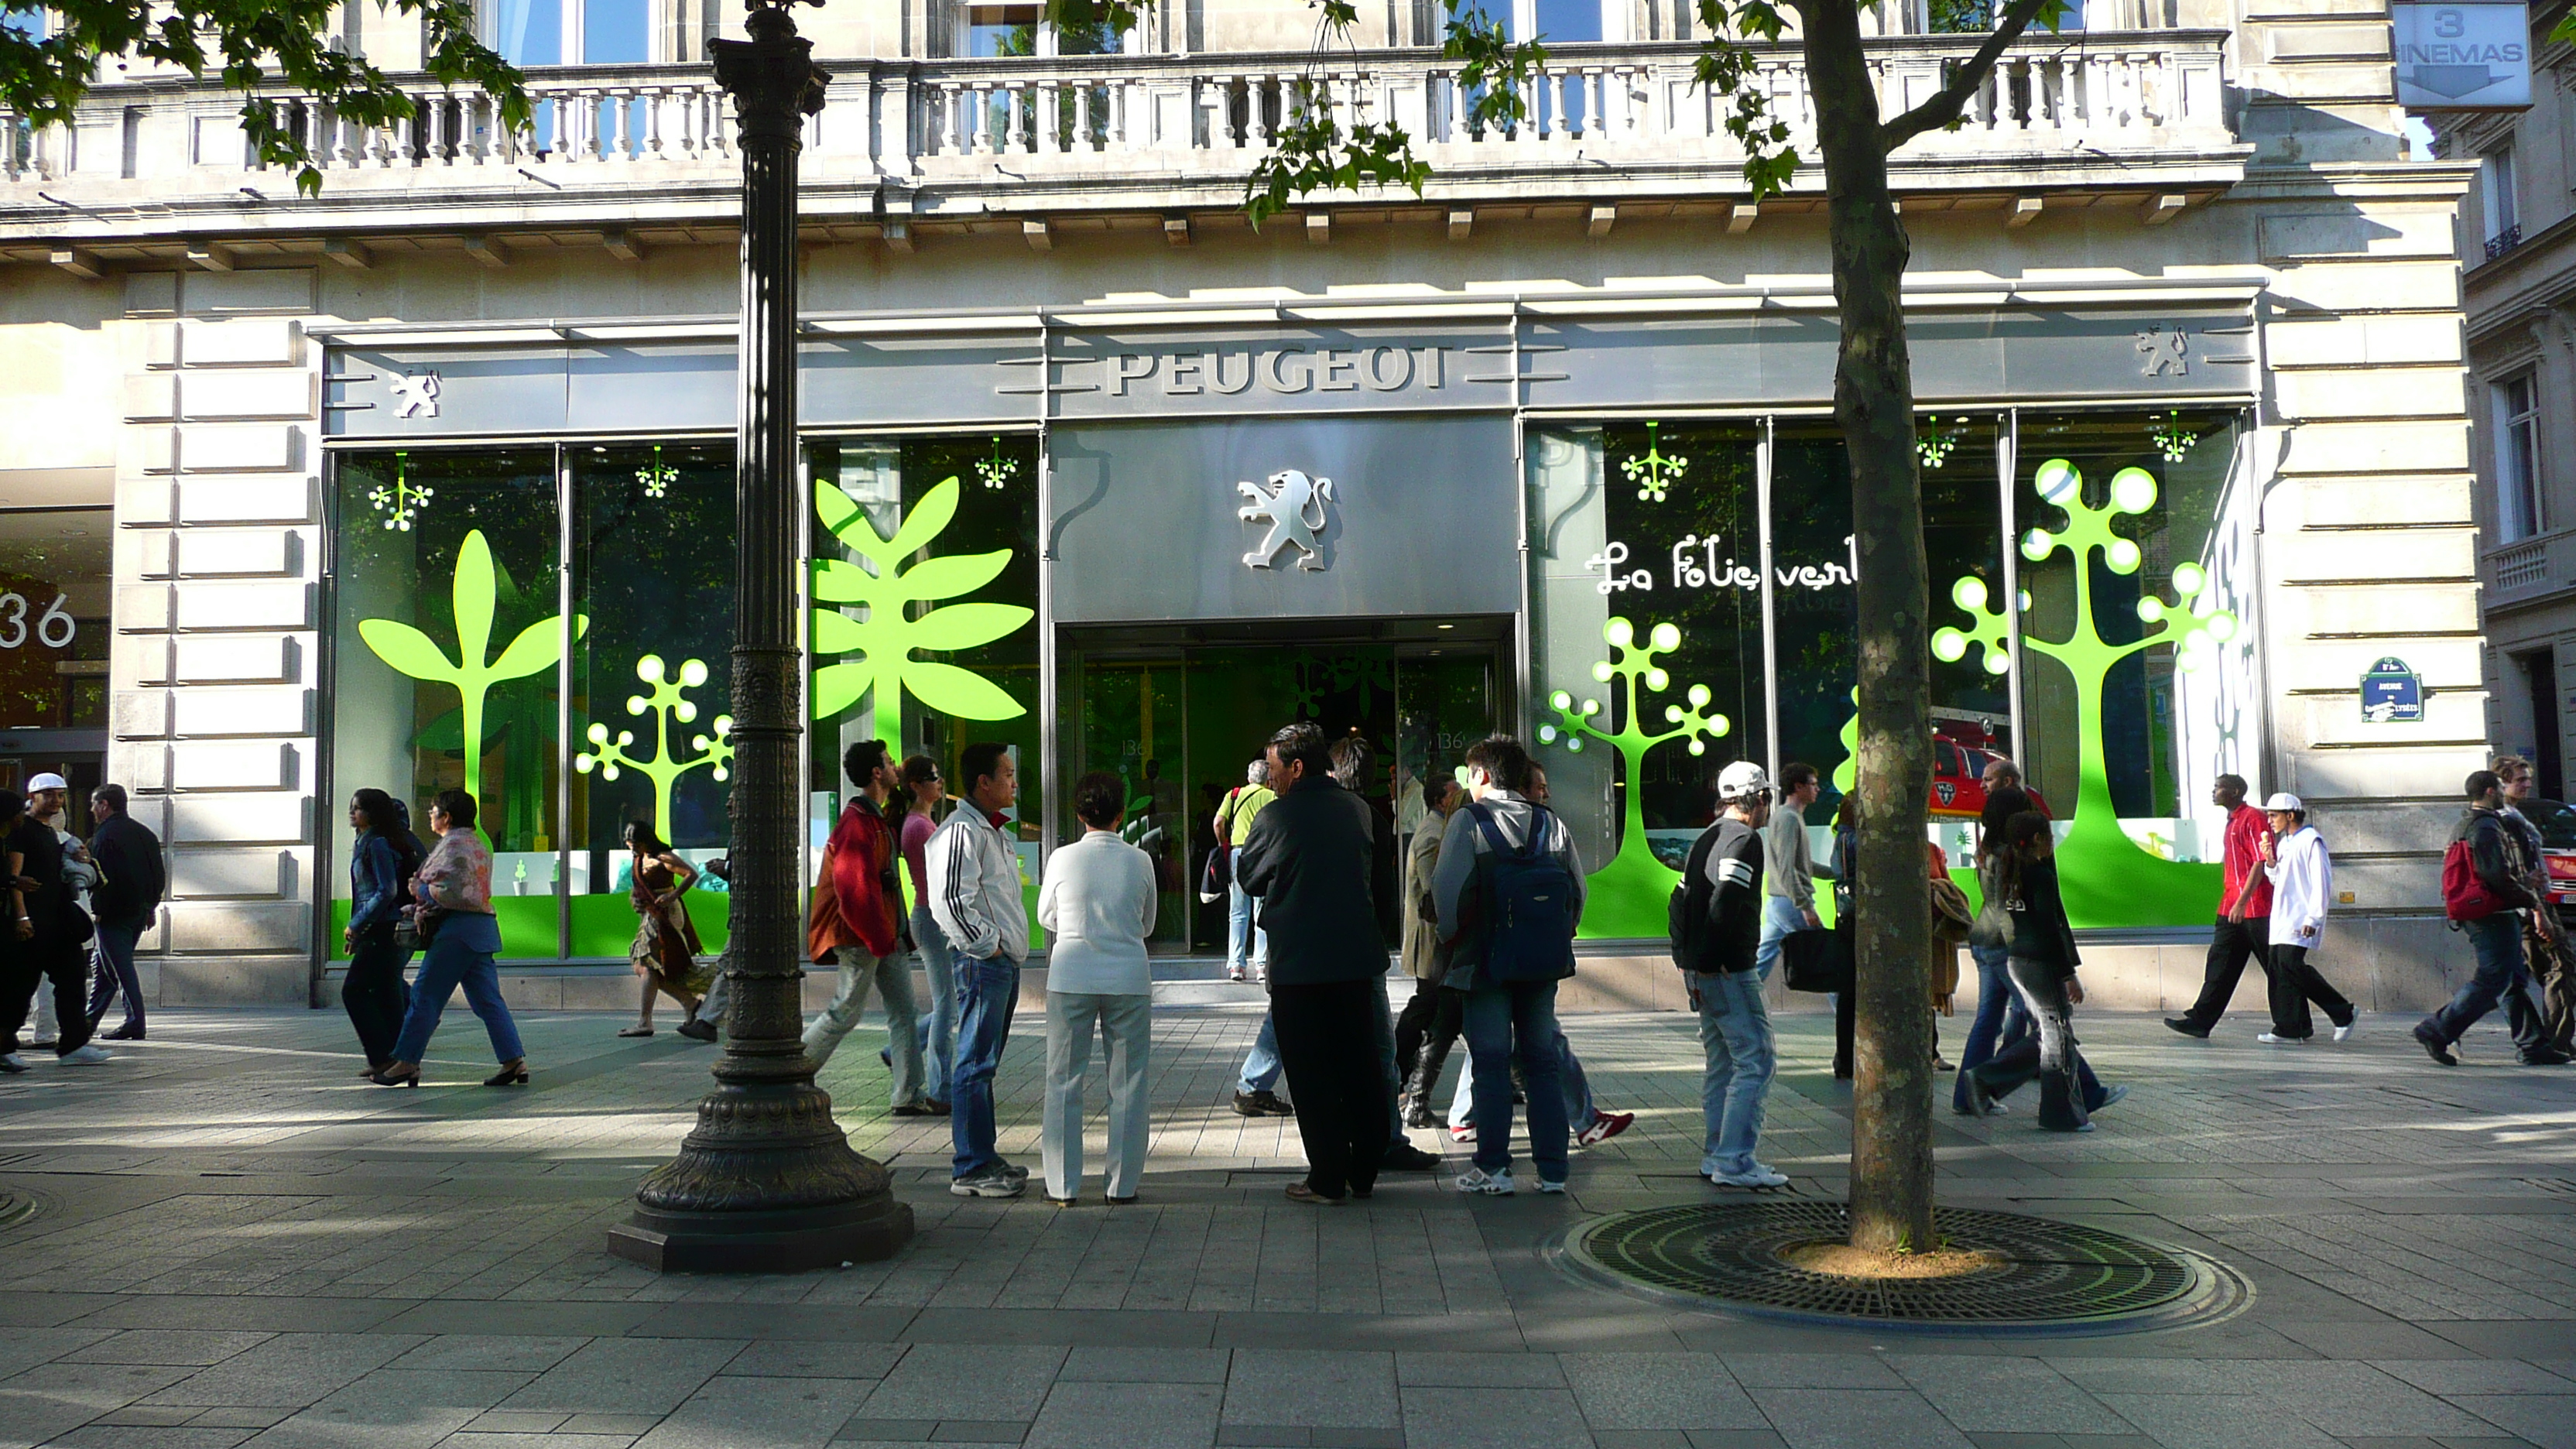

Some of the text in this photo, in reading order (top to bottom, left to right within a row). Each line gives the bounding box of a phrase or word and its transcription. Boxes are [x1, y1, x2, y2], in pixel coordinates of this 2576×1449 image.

[2434, 9, 2465, 38] 3
[2396, 43, 2523, 63] INEMAS
[1107, 344, 1452, 396] PEUGEOT
[1584, 541, 1653, 595] La
[1774, 533, 1858, 591] vert
[0, 592, 76, 648] 36
[1437, 731, 1463, 749] 136
